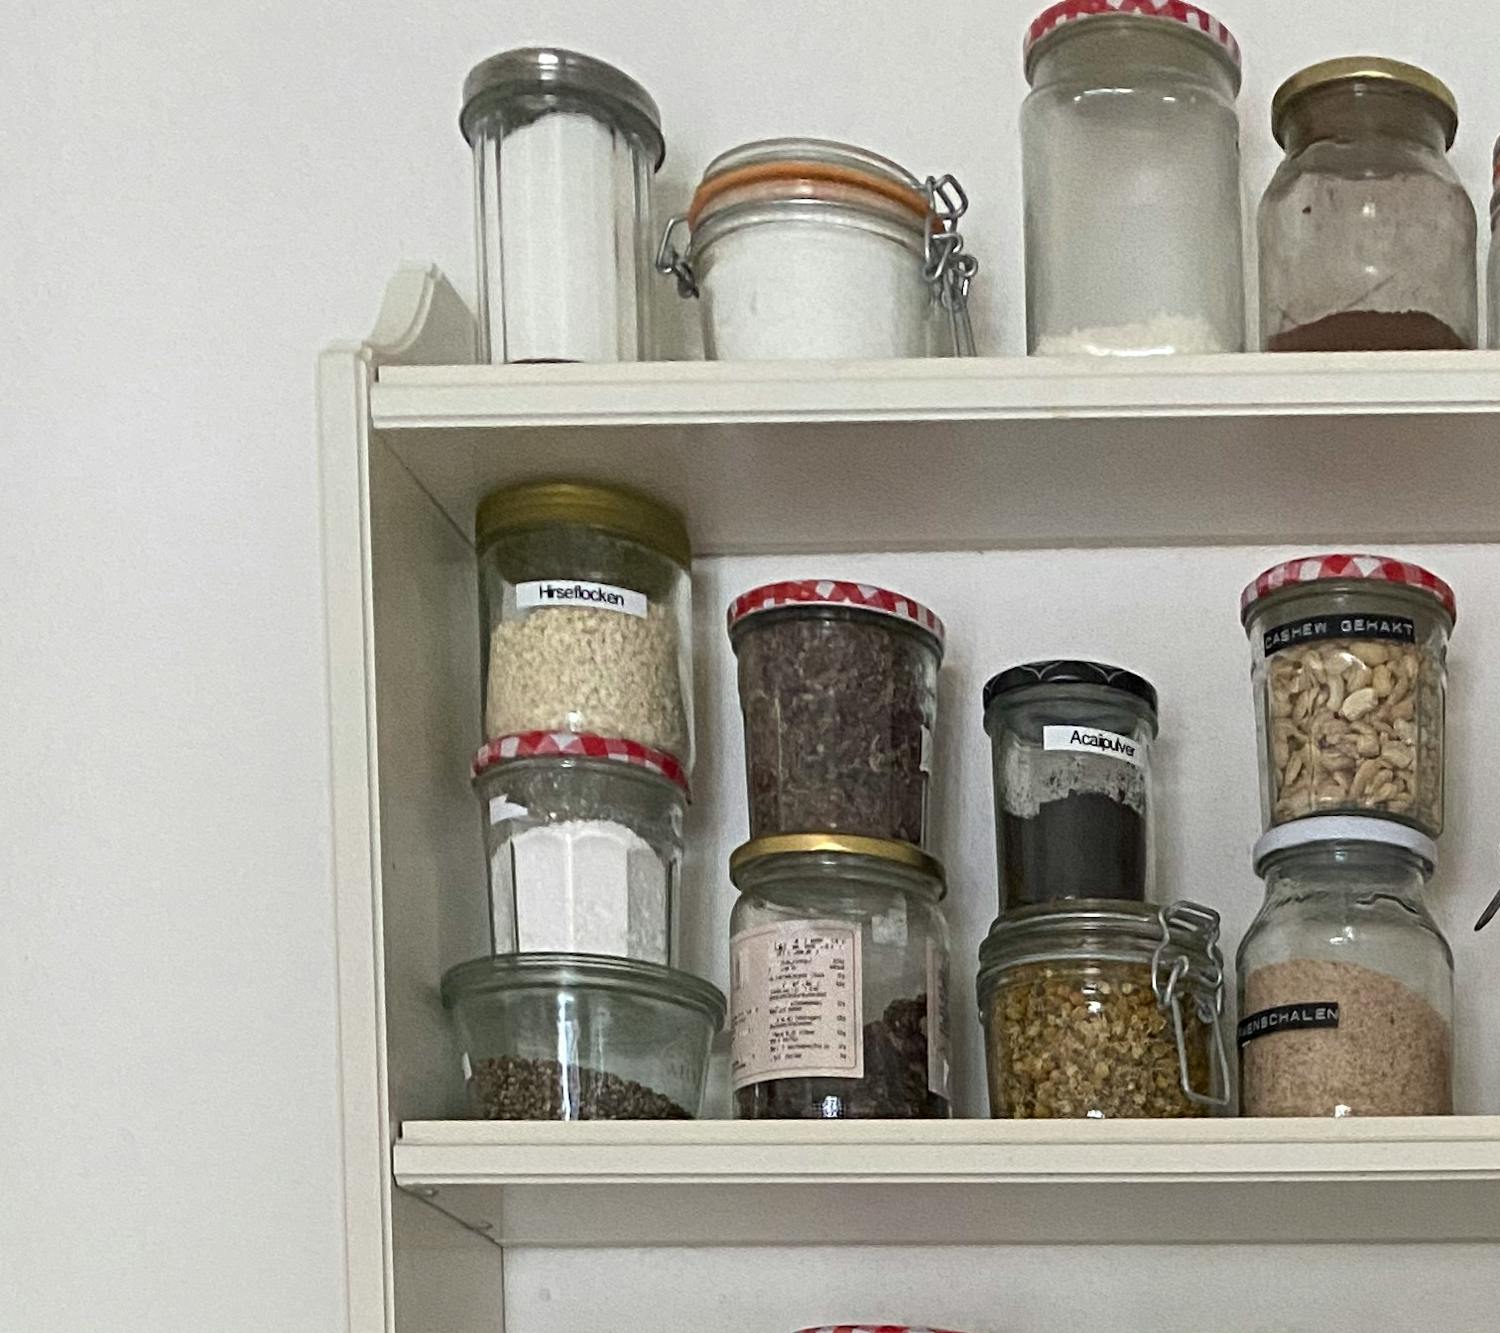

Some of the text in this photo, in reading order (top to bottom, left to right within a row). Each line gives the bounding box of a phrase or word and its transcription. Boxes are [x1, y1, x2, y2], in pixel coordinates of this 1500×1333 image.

[539, 584, 625, 607] Hirseflocken
[1264, 618, 1414, 650] CASHEW GEHAKT
